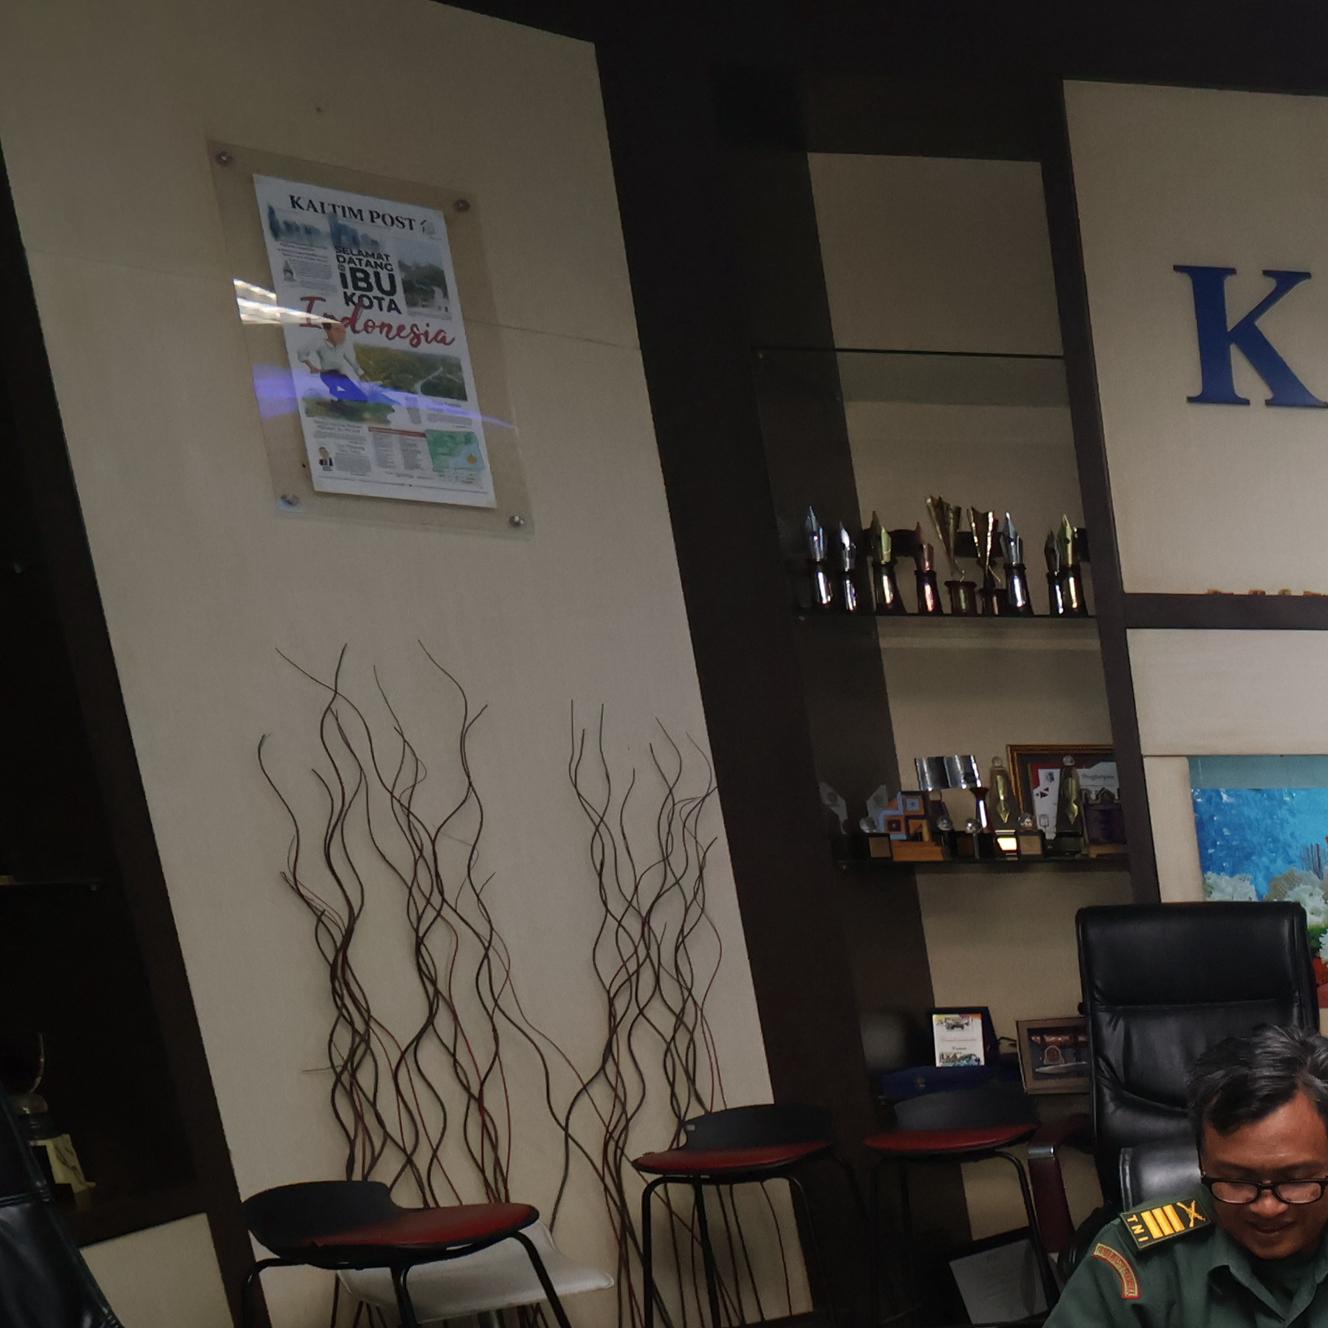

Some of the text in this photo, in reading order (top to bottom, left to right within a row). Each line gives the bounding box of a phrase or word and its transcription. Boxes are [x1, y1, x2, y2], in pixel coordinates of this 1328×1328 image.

[289, 194, 416, 231] KALTIM POST
[336, 246, 390, 262] SELAMAT
[337, 255, 394, 271] DATANG
[343, 291, 402, 315] KOTA
[1127, 1214, 1149, 1242] TNI
